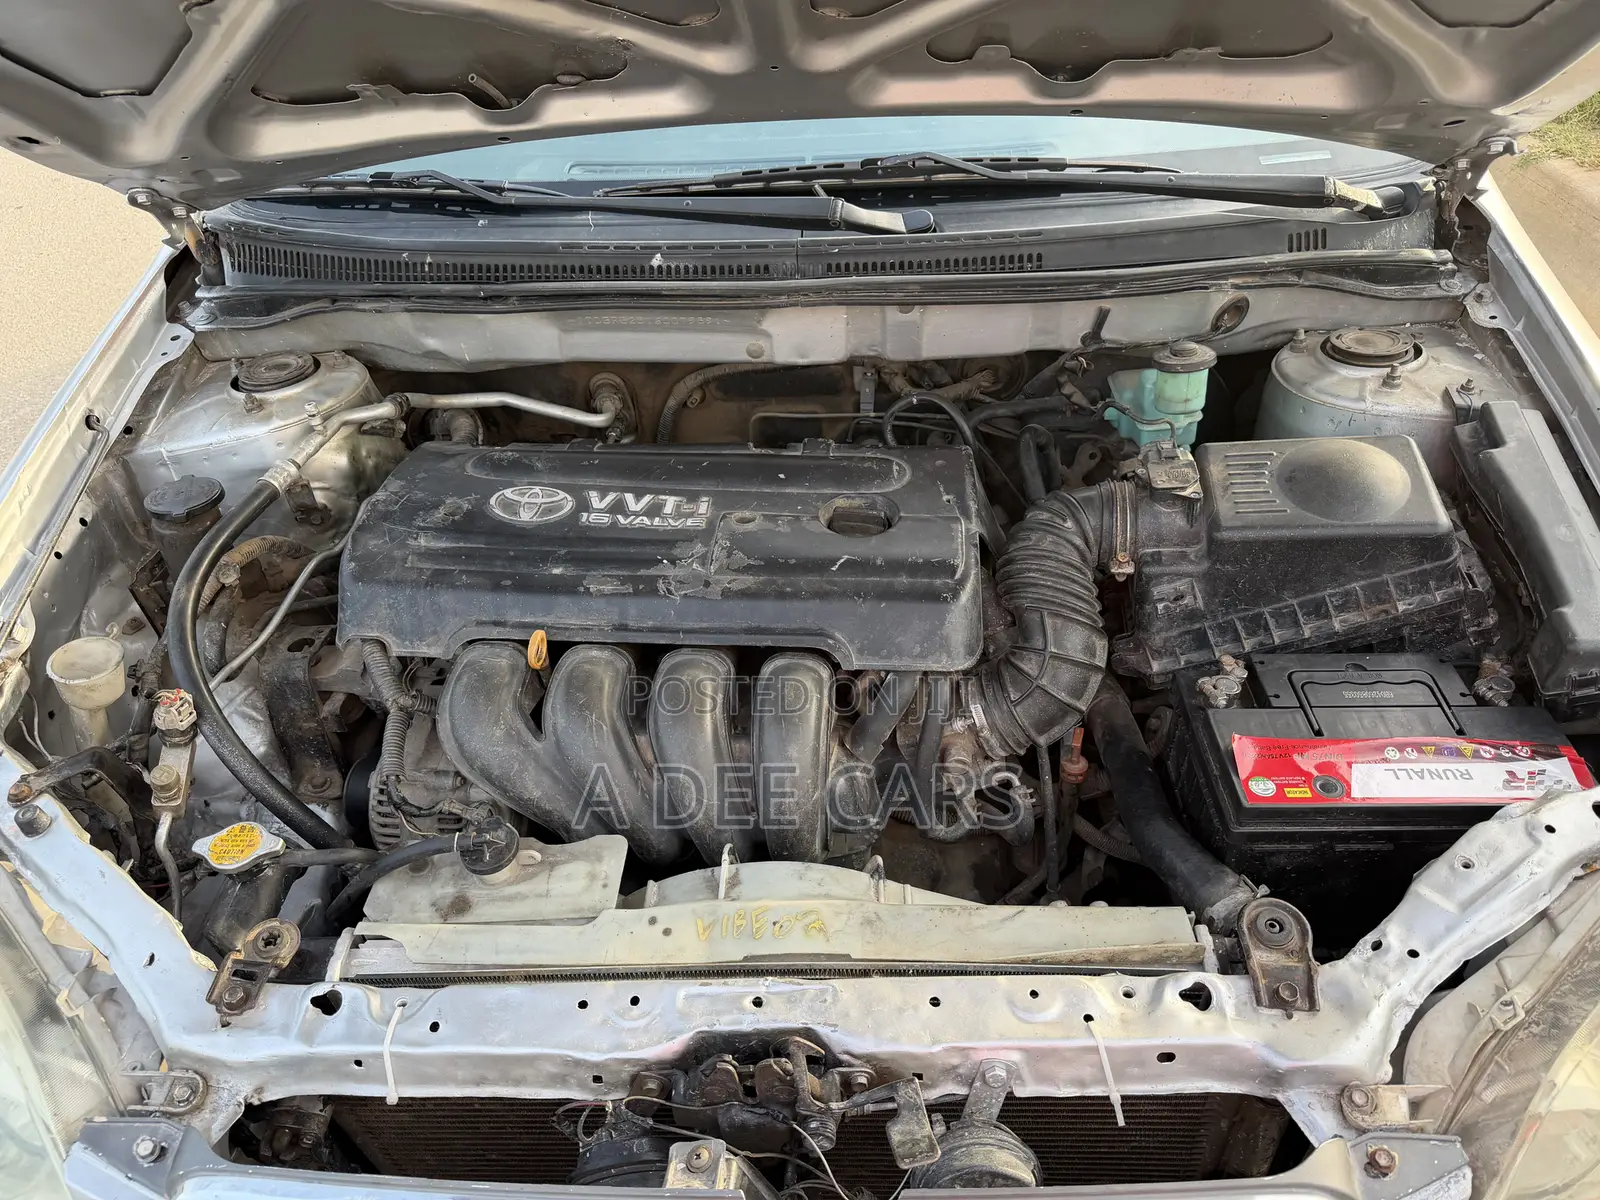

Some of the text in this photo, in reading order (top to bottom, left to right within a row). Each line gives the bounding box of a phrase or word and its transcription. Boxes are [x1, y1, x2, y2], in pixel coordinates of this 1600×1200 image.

[579, 512, 707, 529] 16 VALVE
[1384, 768, 1475, 781] RUNALL
